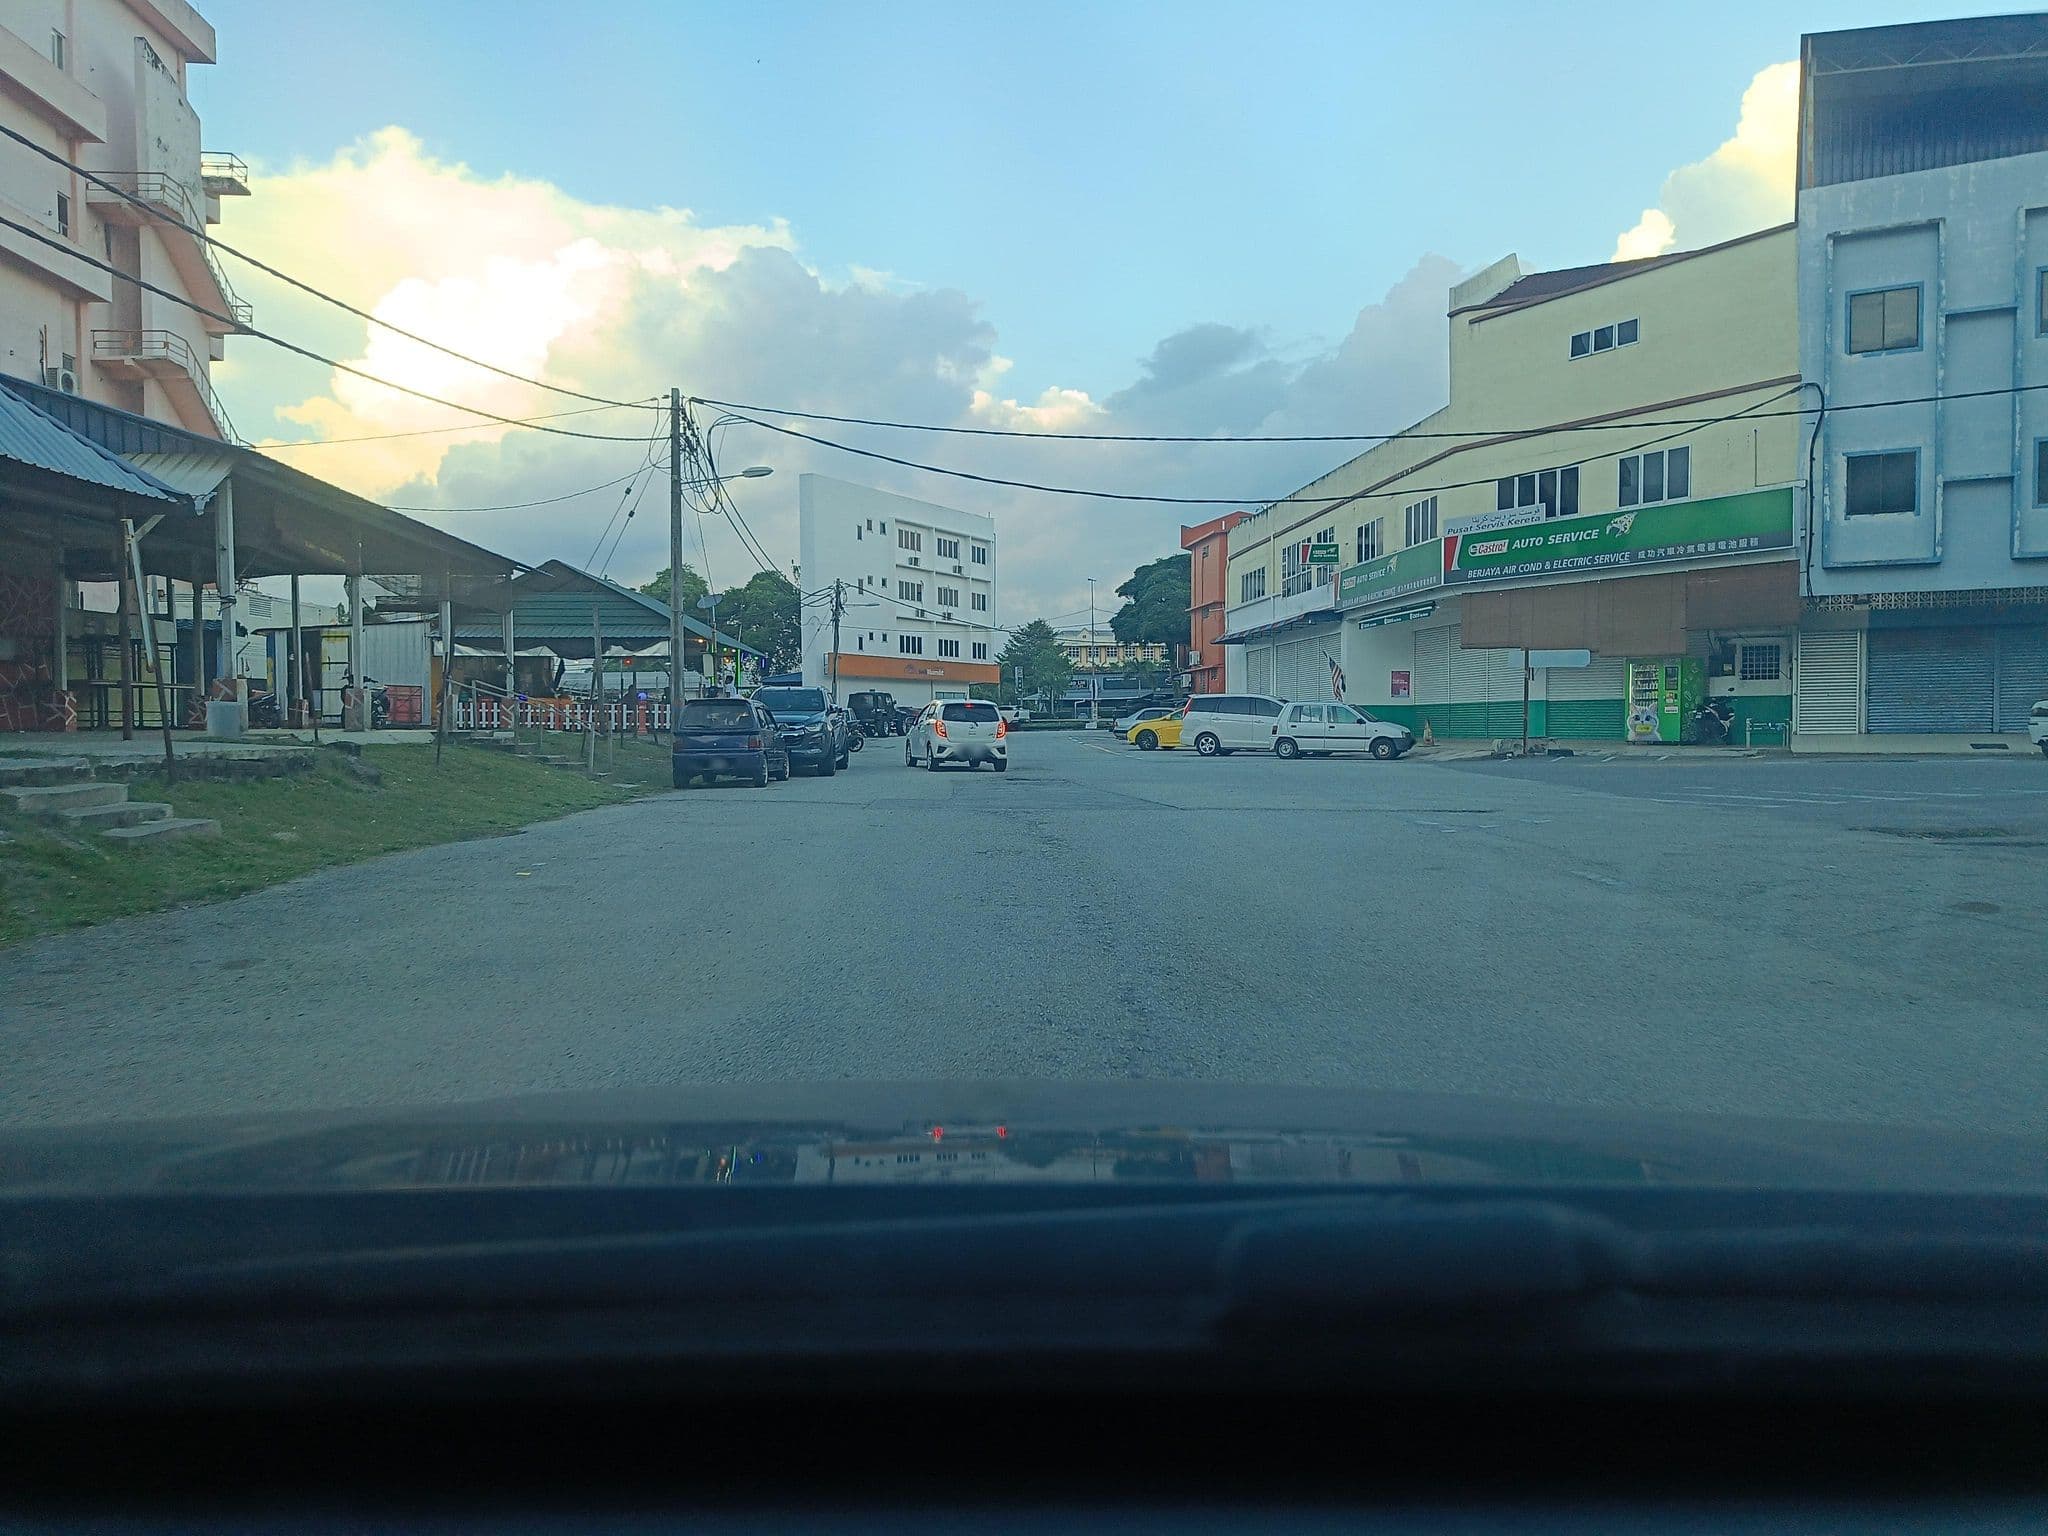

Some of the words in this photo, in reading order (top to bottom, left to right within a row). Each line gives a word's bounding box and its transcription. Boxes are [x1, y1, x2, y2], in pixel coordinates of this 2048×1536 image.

[1447, 526, 1473, 535] Pusat
[1475, 519, 1504, 530] Servis
[1507, 515, 1540, 526] Kereta
[1478, 541, 1507, 554] Castrol
[1512, 536, 1543, 549] AUTO
[1547, 529, 1599, 544] SERVICE
[1467, 567, 1500, 578] BERJAYA
[1502, 565, 1516, 574] AIR
[1518, 562, 1542, 573] COND
[1544, 561, 1551, 569] &
[1553, 556, 1592, 569] ELECTRIC
[1594, 552, 1630, 564] SERVICE
